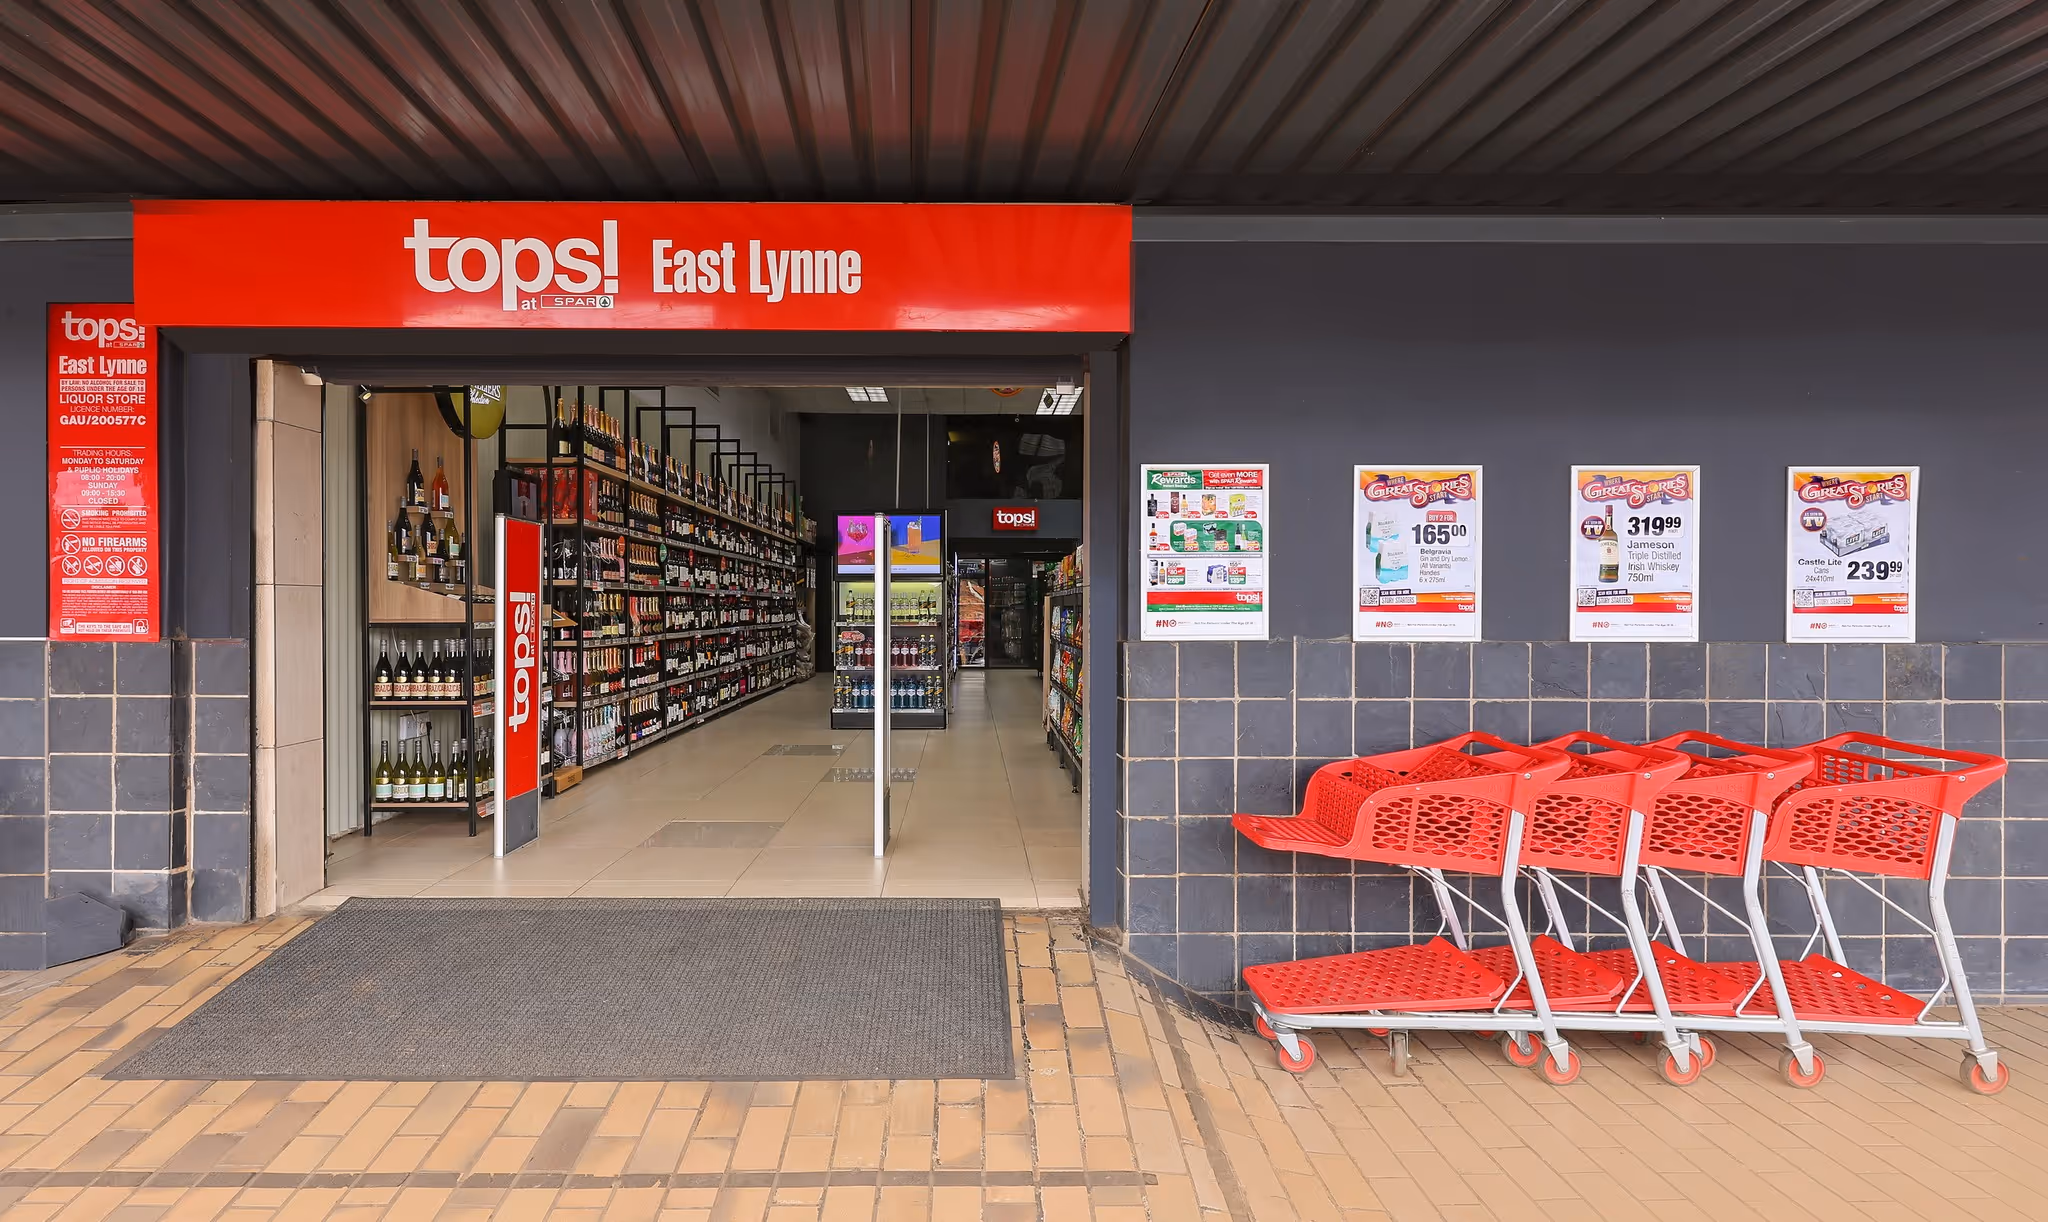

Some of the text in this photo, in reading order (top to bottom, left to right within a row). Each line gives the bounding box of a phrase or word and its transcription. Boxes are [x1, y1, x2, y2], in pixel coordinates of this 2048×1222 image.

[404, 219, 618, 310] tops!
[652, 239, 863, 302] East Lynne
[521, 297, 596, 310] at SPAR
[59, 356, 147, 377] East Lynne
[60, 394, 146, 404] LIQUOR STORE
[60, 415, 146, 425] GAU/200577C
[1151, 473, 1197, 485] Rewards
[1387, 477, 1404, 486] WHERE
[1604, 477, 1621, 486] WHERE
[1368, 476, 1468, 505] GREAT STORIES
[1585, 476, 1685, 505] GREAT STORIES
[1802, 477, 1904, 506] GREAT STORIES
[1430, 492, 1448, 502] START
[1646, 492, 1664, 502] START
[1866, 493, 1883, 502] START
[996, 510, 1035, 526] tops!
[1803, 517, 1824, 526] TV
[1584, 524, 1603, 535] TV
[82, 537, 147, 546] NO FIREARMS
[1627, 541, 1674, 549] Jameson
[1628, 551, 1681, 561] Triple Distilled
[1628, 562, 1680, 572] Irish Whiskey
[1628, 573, 1653, 582] 750ml
[1236, 592, 1260, 603] tops!
[508, 592, 534, 732] tops!
